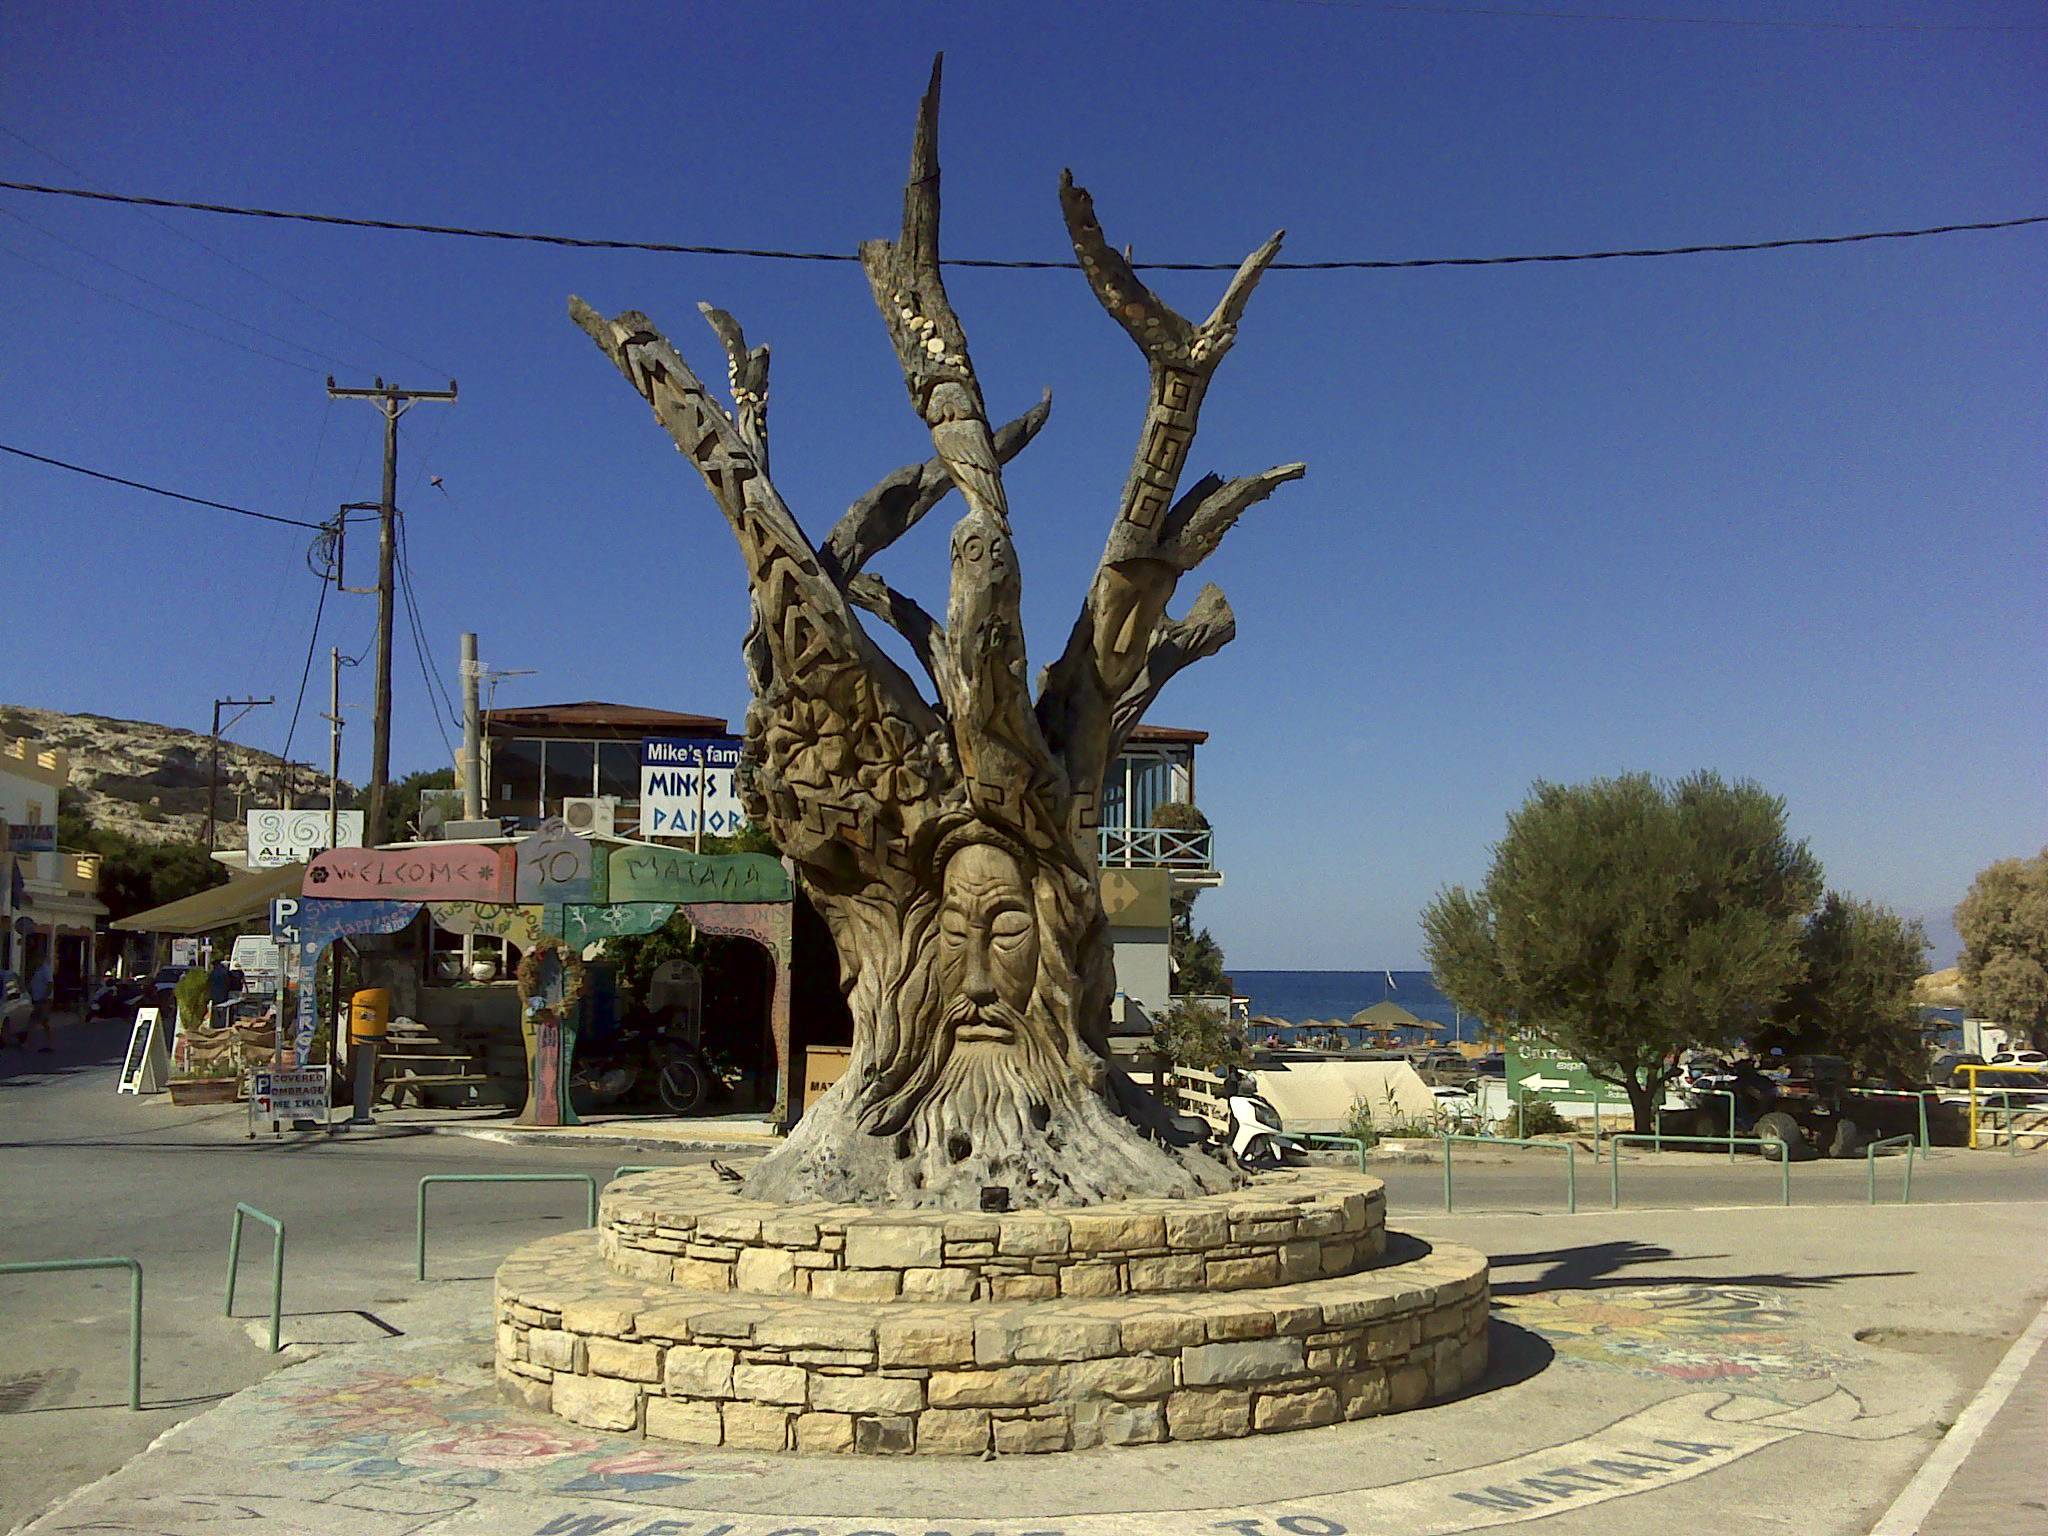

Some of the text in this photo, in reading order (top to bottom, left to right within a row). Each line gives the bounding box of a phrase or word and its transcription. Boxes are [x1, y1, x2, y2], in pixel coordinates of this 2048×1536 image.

[648, 743, 702, 761] Mike's
[653, 807, 741, 832] PANOR
[260, 847, 301, 856] ALL
[332, 862, 470, 885] WELCOME
[529, 851, 579, 885] TO
[275, 898, 299, 925] P
[257, 1077, 270, 1094] P
[272, 1073, 323, 1082] COVERED
[810, 1081, 835, 1092] MAT
[1450, 1439, 1732, 1513] MATALA
[1212, 1514, 1347, 1536] TO
